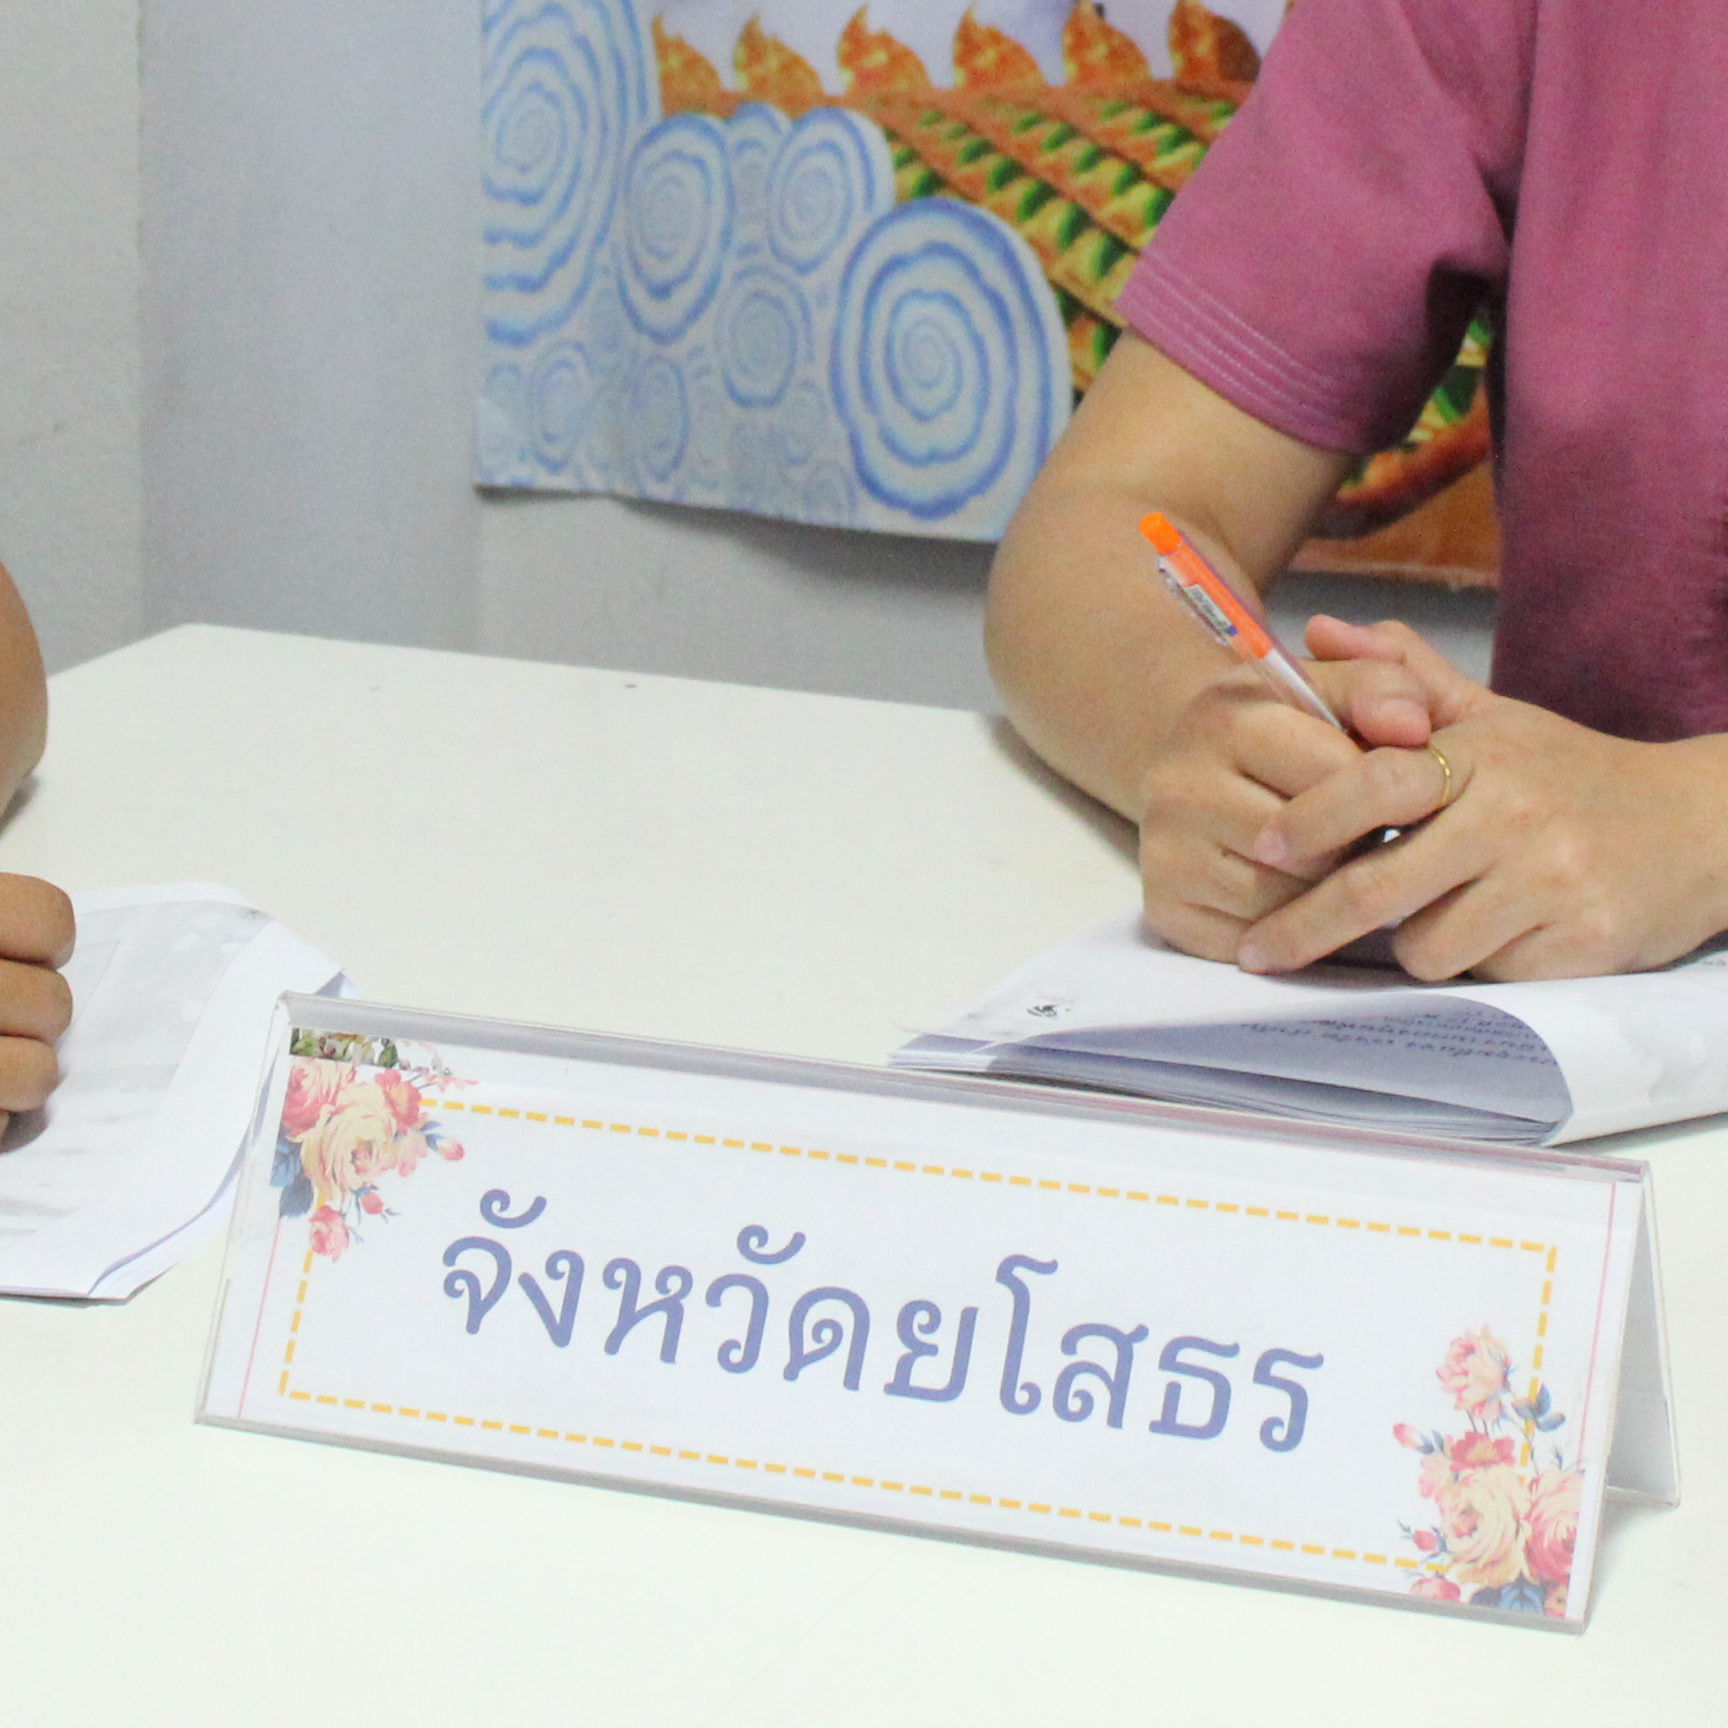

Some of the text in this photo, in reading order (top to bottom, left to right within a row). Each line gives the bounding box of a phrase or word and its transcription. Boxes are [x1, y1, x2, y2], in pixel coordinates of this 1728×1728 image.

[440, 1188, 1325, 1454] จังหวัดยโสธร
